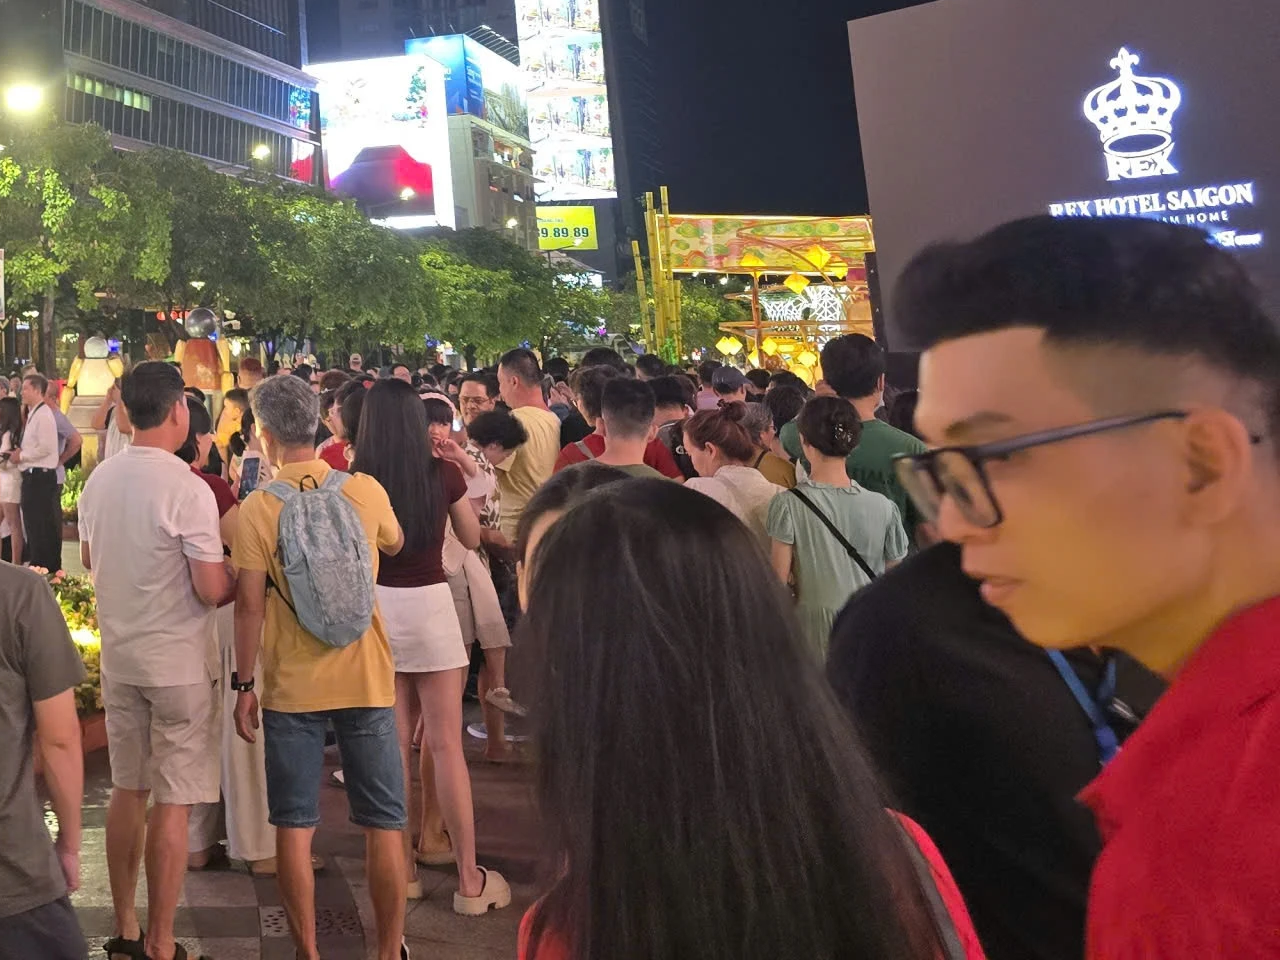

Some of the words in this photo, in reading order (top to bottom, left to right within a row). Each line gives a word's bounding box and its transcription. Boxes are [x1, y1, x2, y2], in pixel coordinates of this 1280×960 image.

[1048, 202, 1094, 219] REX
[1095, 192, 1167, 218] HOTEL
[1167, 182, 1255, 212] SAIGON
[1186, 209, 1230, 224] HOME
